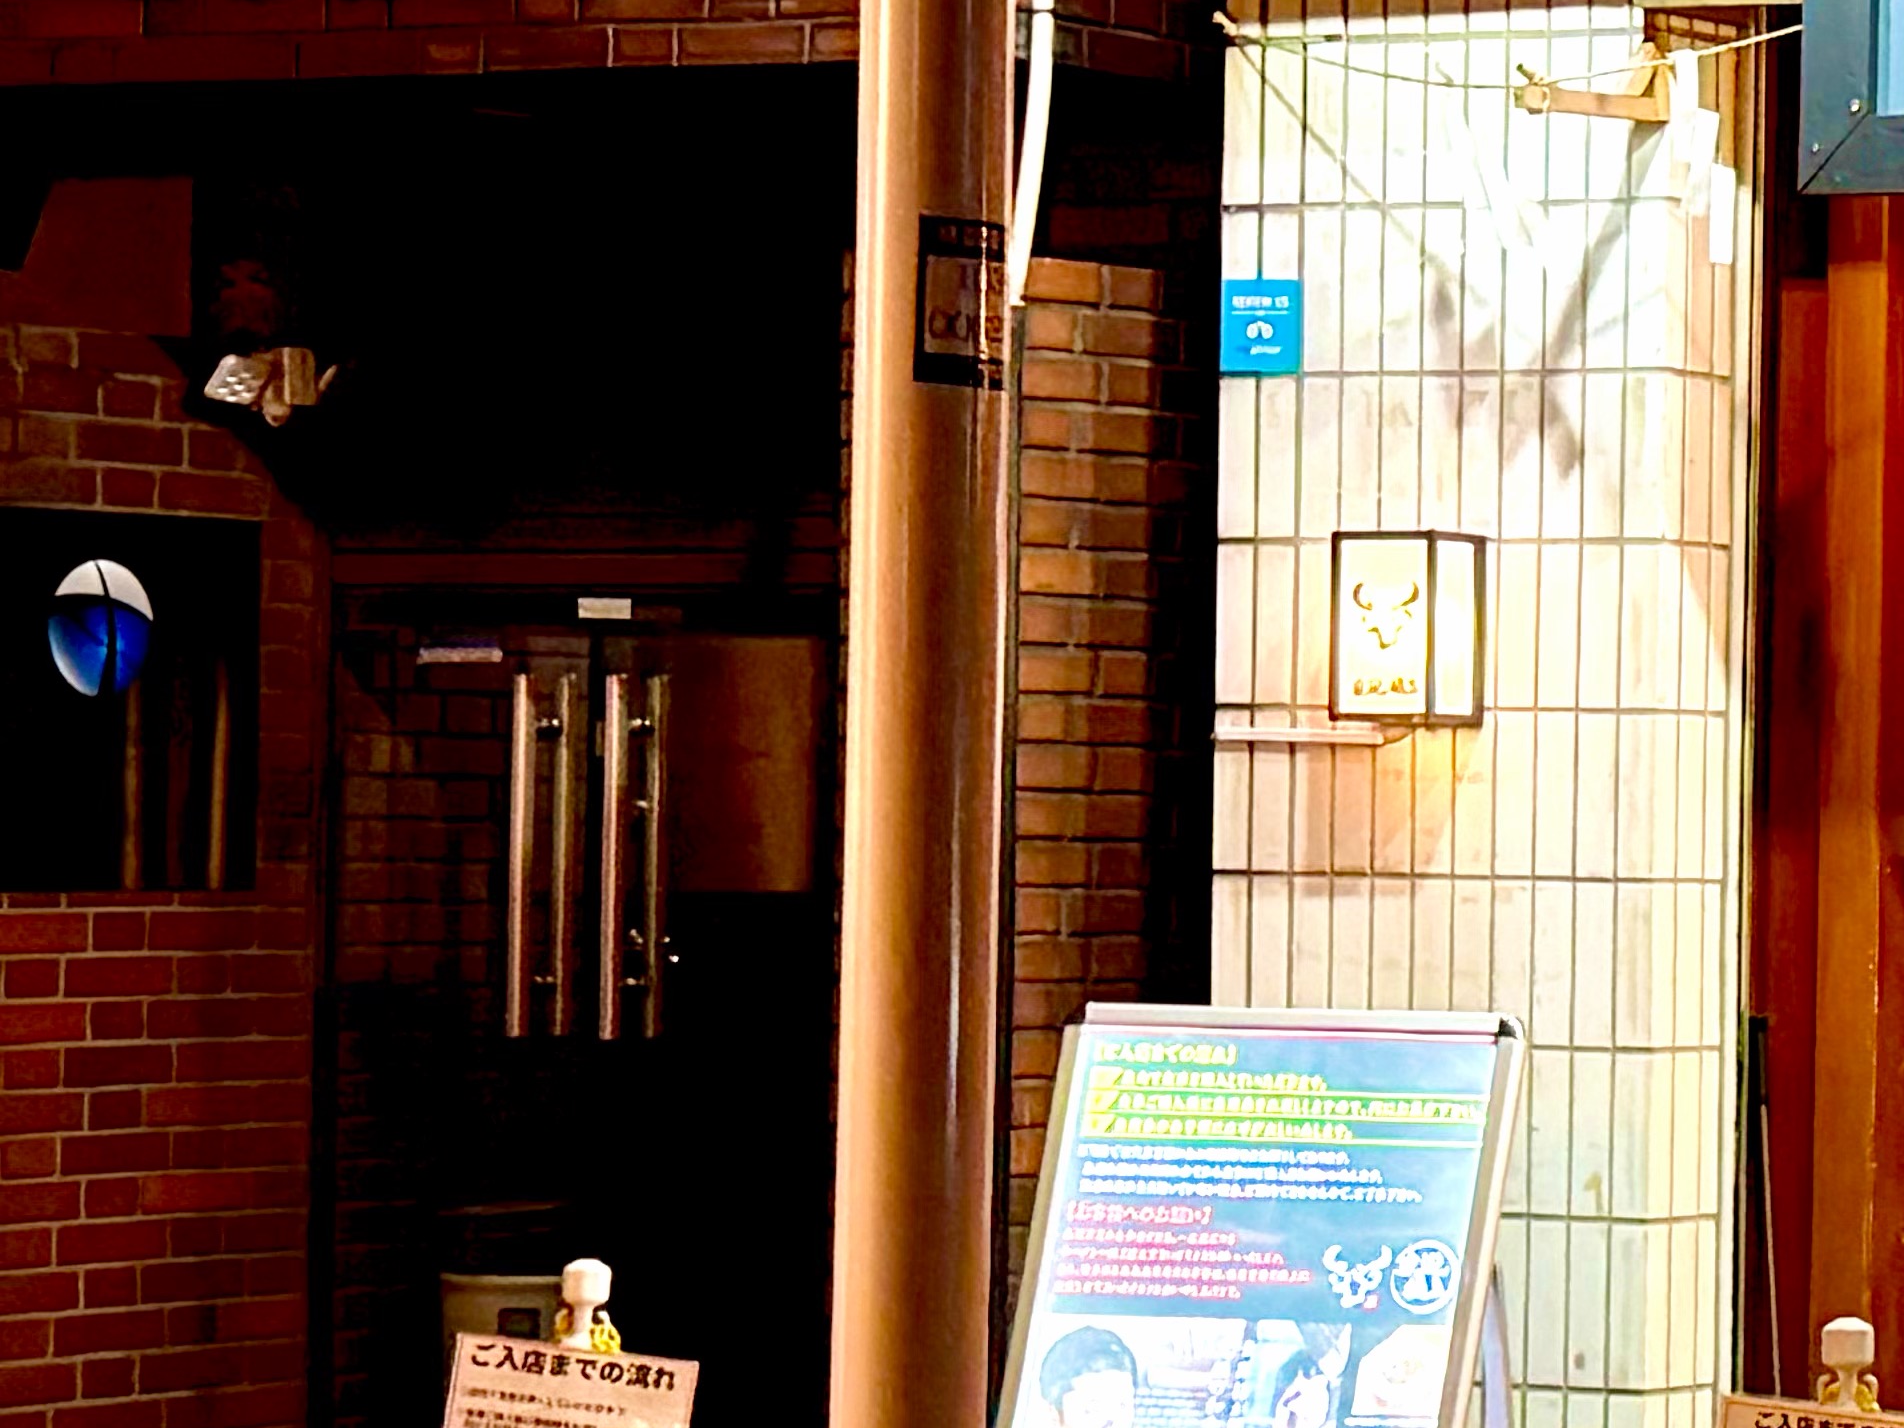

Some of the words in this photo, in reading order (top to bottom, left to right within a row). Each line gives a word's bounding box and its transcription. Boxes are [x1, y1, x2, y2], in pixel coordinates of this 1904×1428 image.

[471, 1344, 675, 1390] ご入店までの流れ
